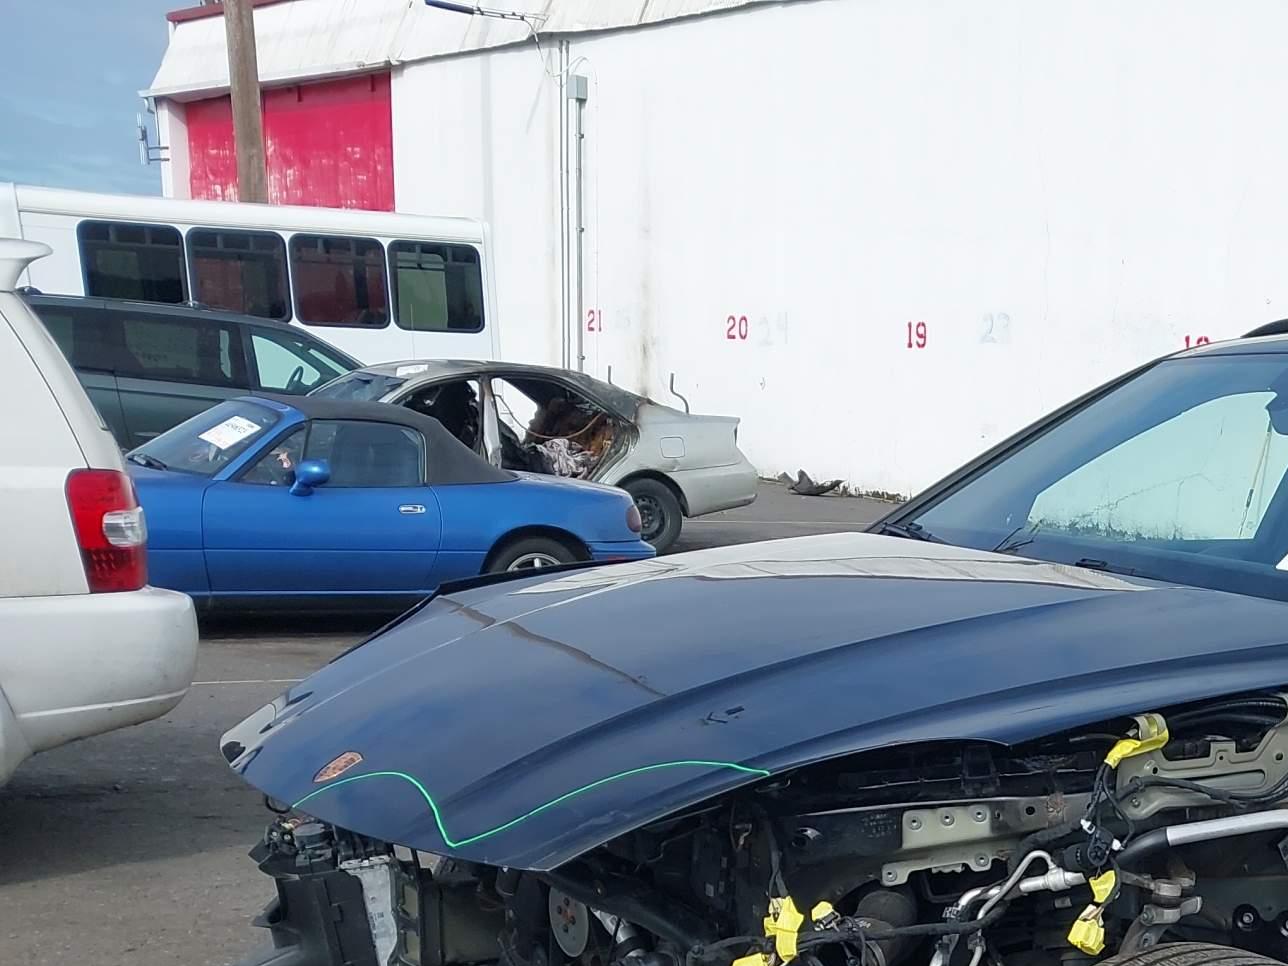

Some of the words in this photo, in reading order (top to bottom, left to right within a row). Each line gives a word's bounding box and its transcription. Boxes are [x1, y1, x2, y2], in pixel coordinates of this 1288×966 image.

[587, 310, 602, 332] 21
[727, 315, 748, 340] 20
[907, 322, 927, 349] 19
